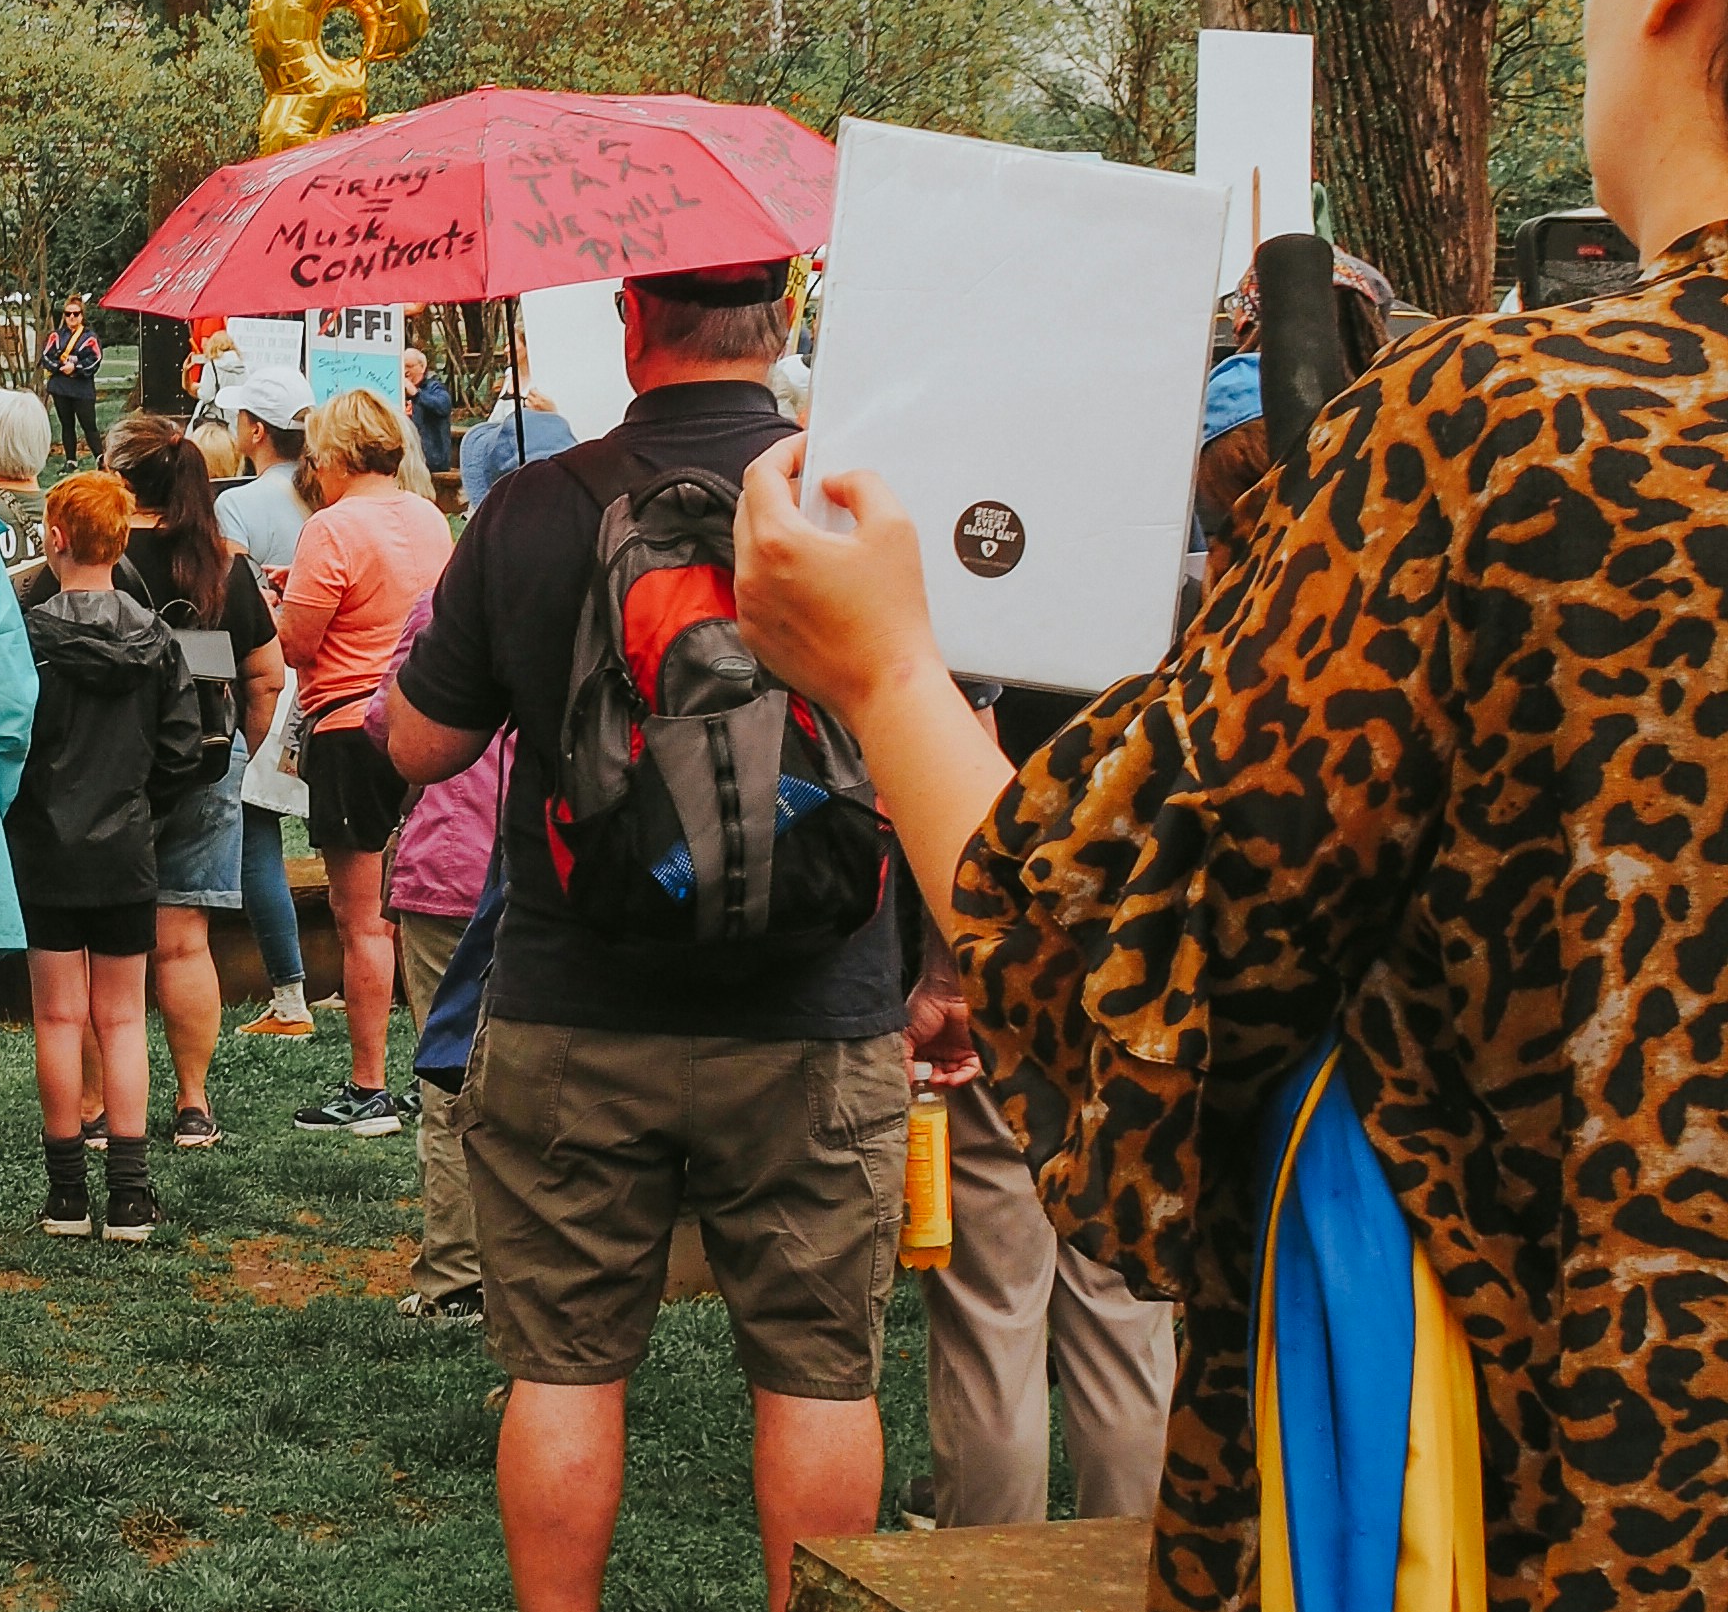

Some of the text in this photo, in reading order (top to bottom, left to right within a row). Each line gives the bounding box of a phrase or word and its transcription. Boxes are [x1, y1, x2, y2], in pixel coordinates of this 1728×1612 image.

[318, 308, 393, 343] OFF!
[974, 507, 1012, 521] RESIST
[975, 517, 1009, 531] EVERY
[963, 524, 1018, 542] DAMN DAY
